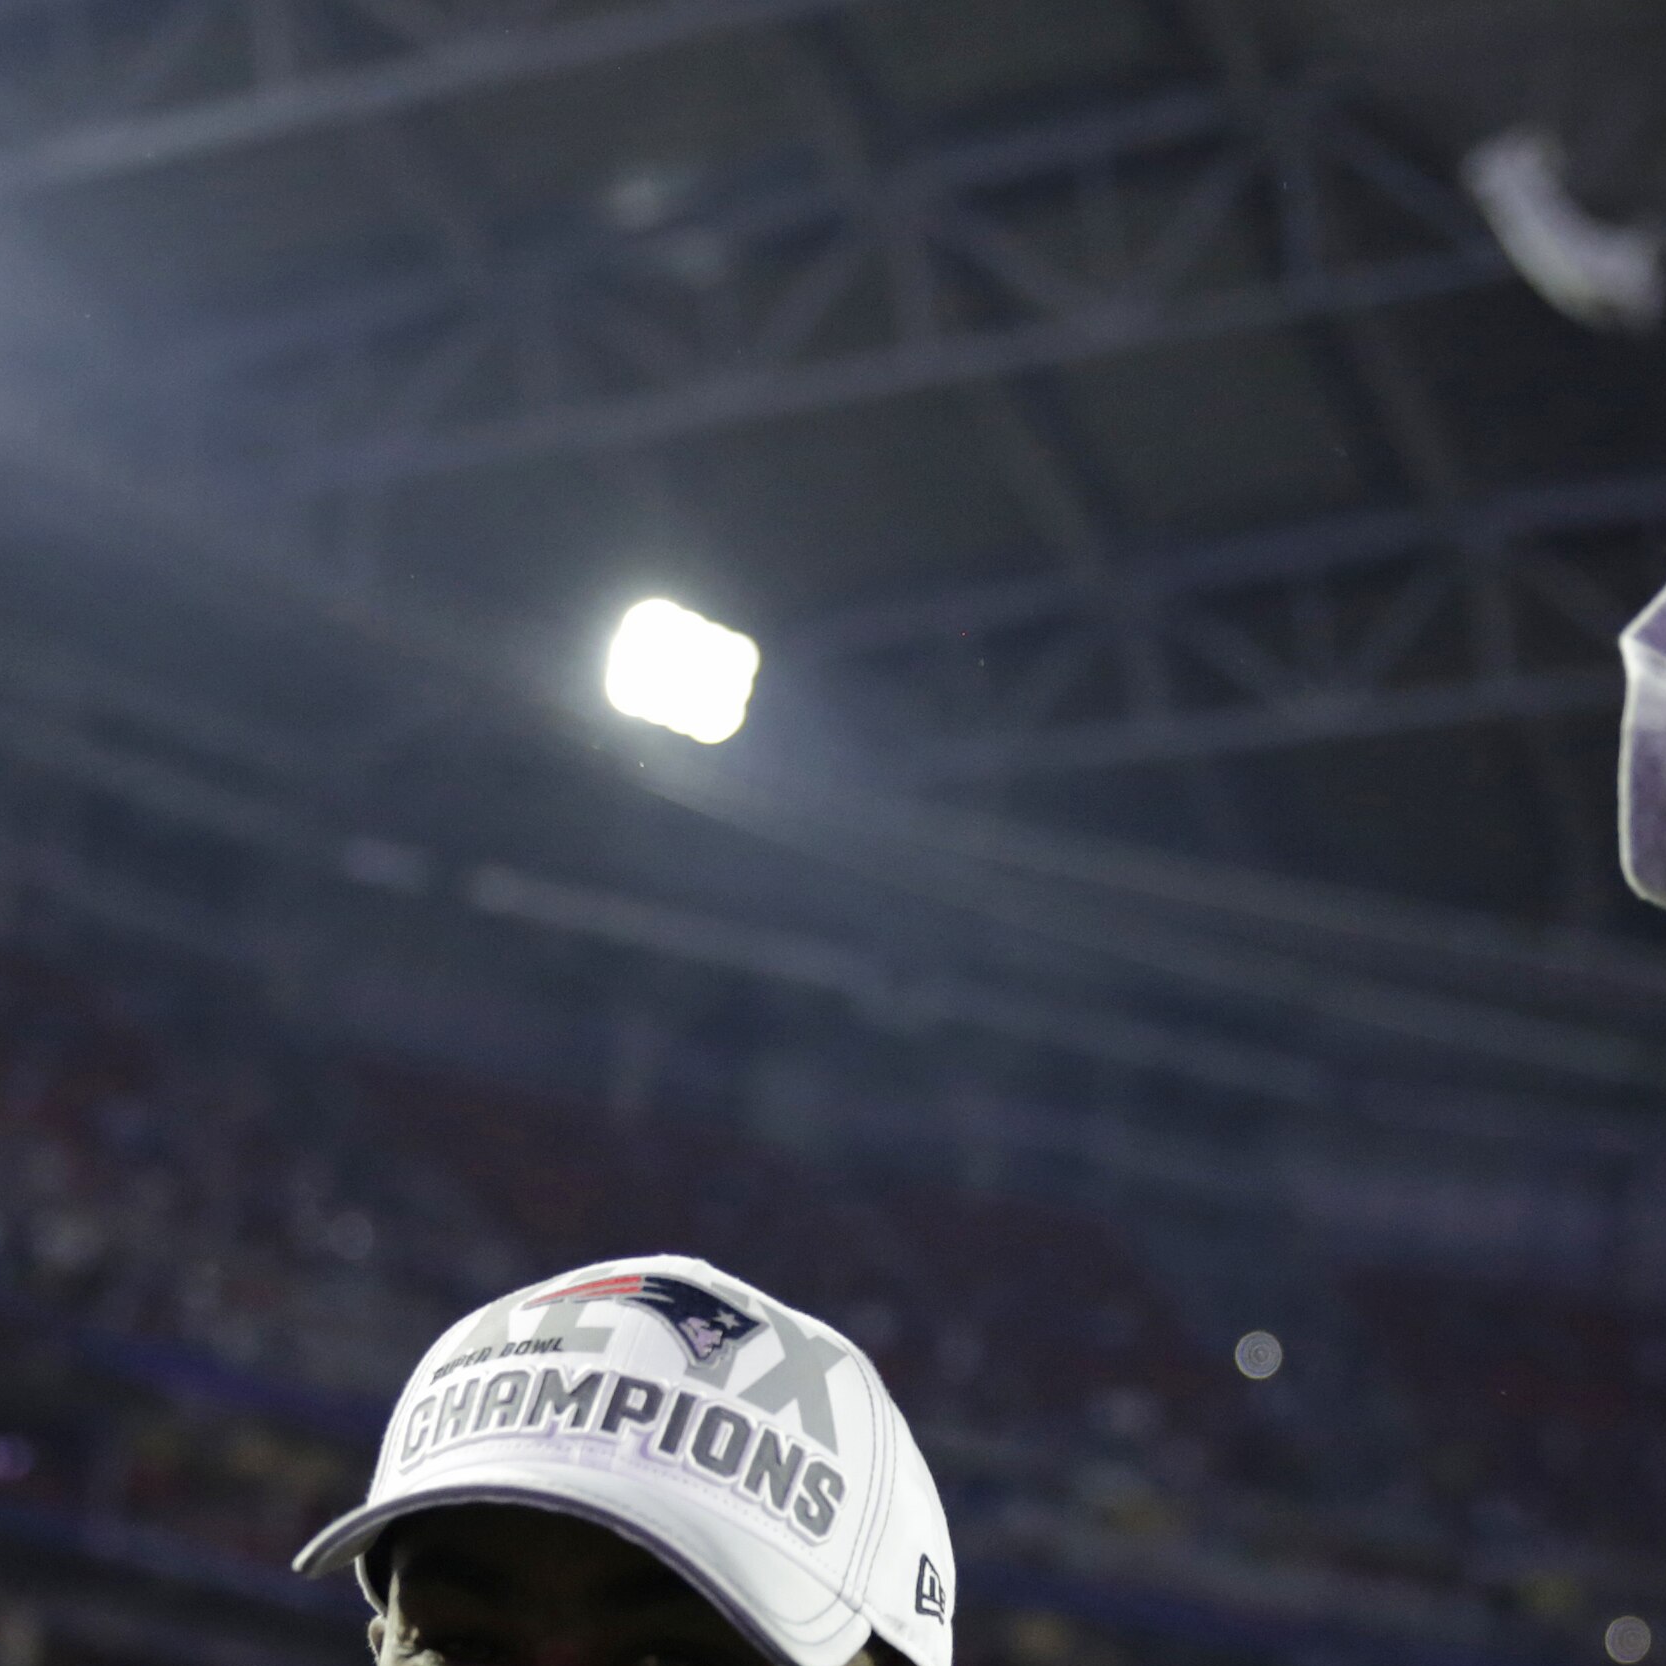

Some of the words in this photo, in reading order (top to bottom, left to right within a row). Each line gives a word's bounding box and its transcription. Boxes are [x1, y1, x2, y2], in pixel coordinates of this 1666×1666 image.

[431, 1346, 493, 1384] SUPER
[499, 1336, 564, 1358] BOWL
[399, 1366, 848, 1541] CHAMPIONS
